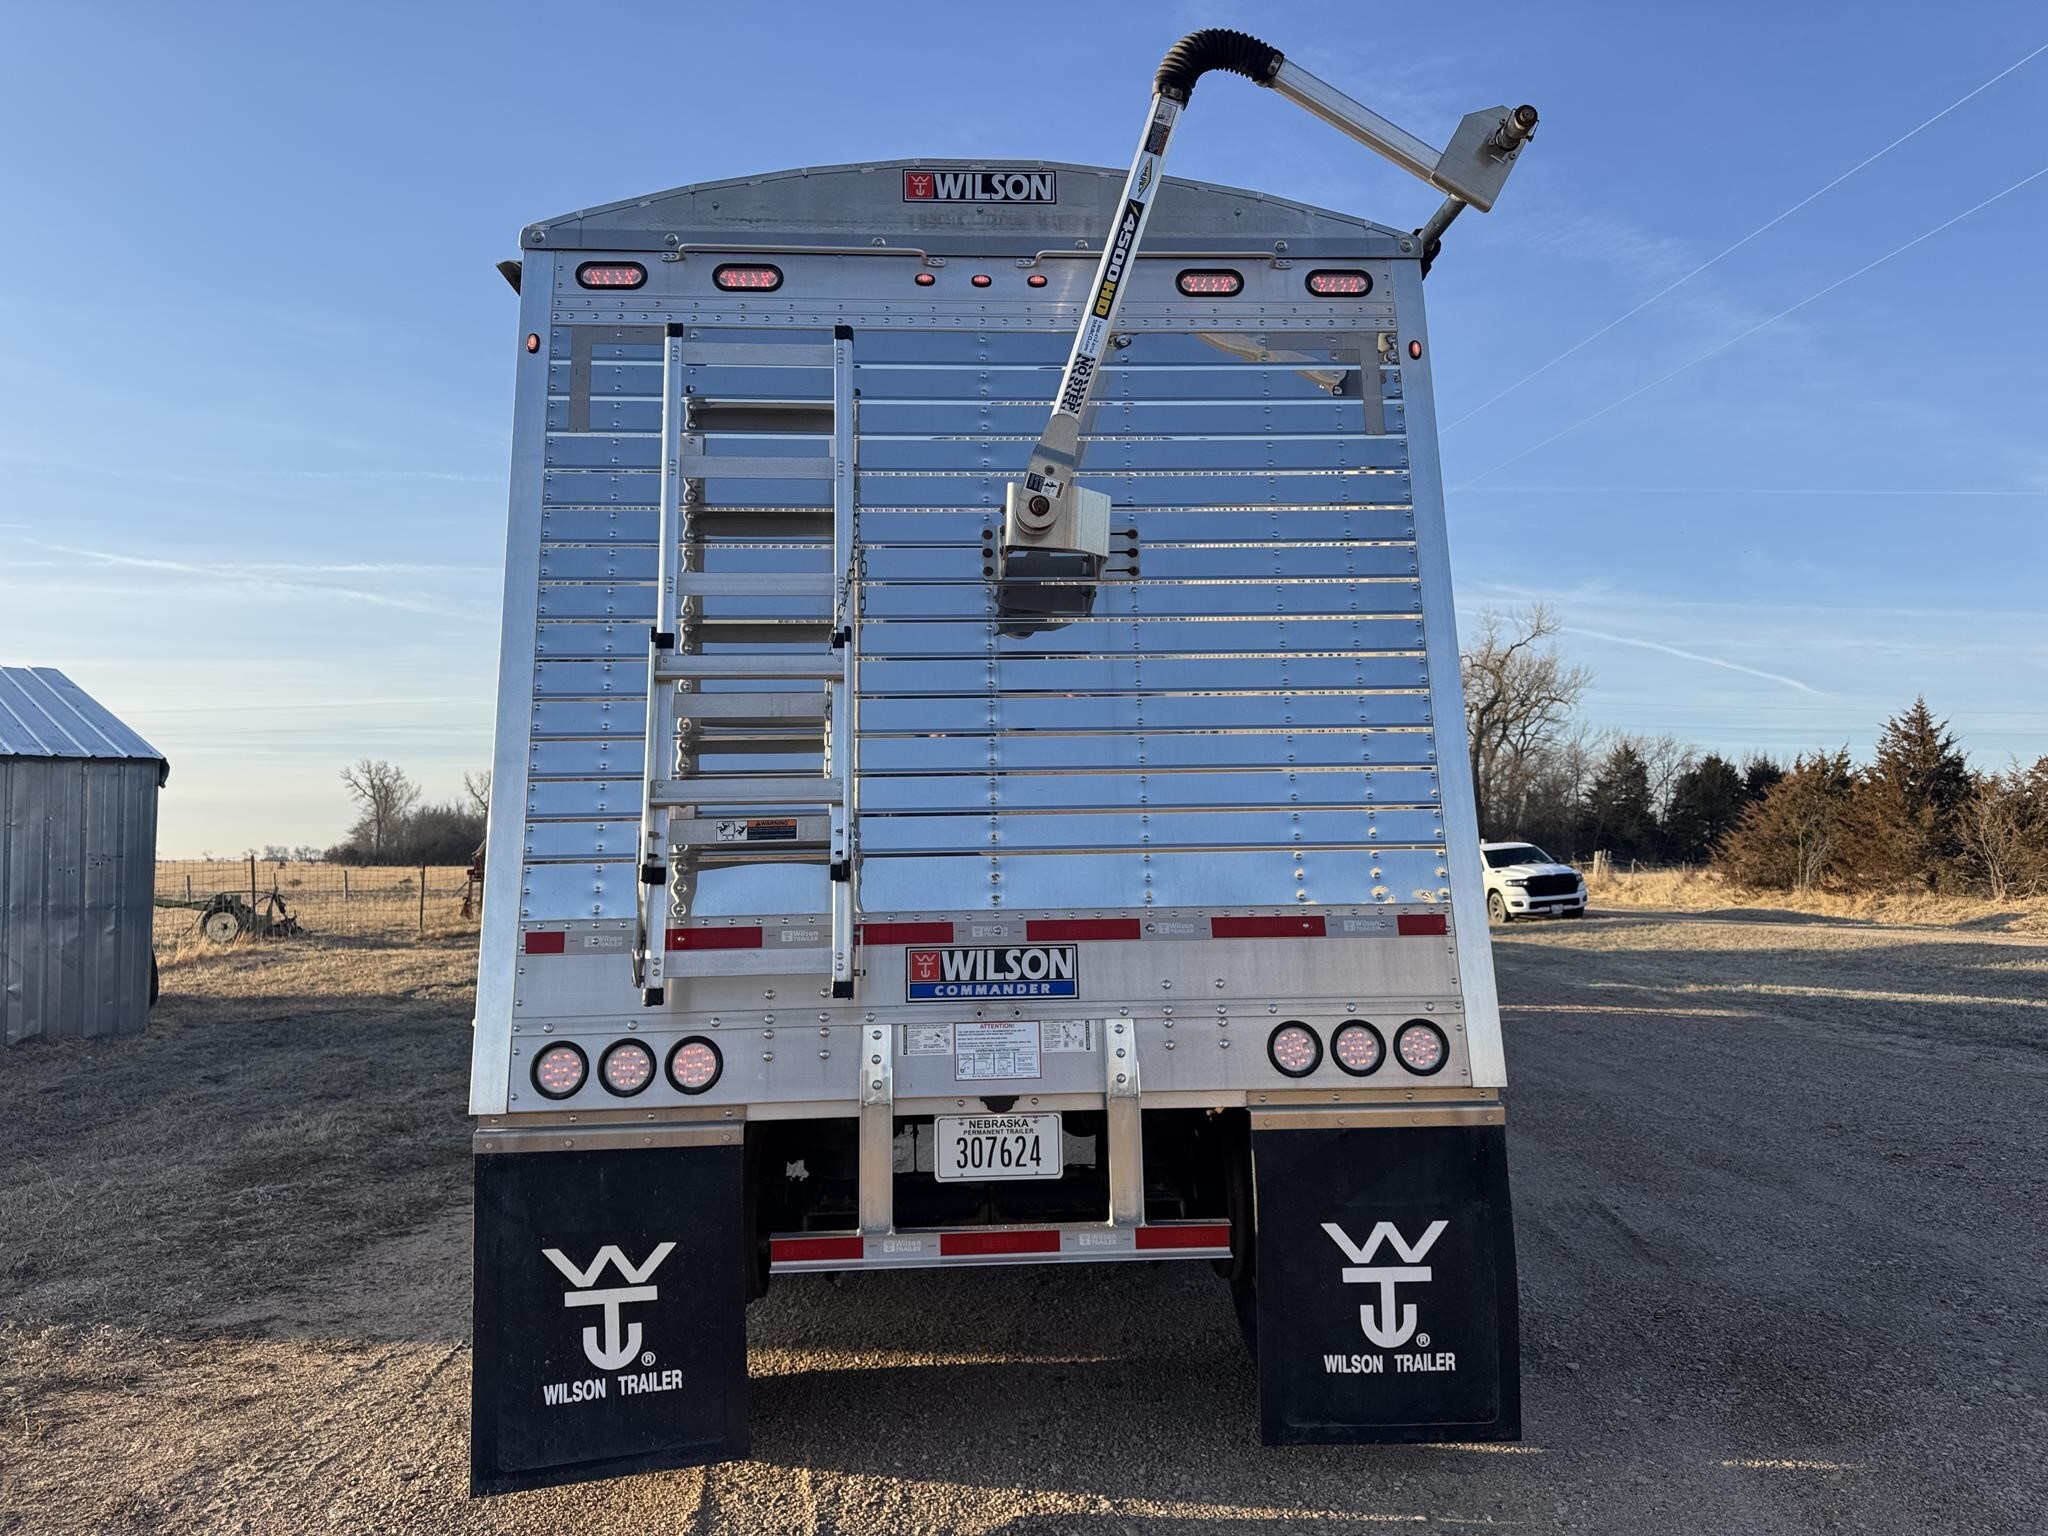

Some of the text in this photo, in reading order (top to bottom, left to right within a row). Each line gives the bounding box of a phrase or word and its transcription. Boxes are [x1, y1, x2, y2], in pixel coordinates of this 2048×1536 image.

[934, 173, 1051, 200] WILSON
[1066, 356, 1090, 411] NO STEP
[941, 948, 1073, 981] WILSON
[934, 983, 1051, 997] COMMANDER
[969, 1119, 1029, 1129] NEBRASKA
[956, 1135, 1041, 1169] 307624
[1323, 1353, 1456, 1374] WILSON TRAILER
[543, 1369, 683, 1406] WILSON TRAILER
